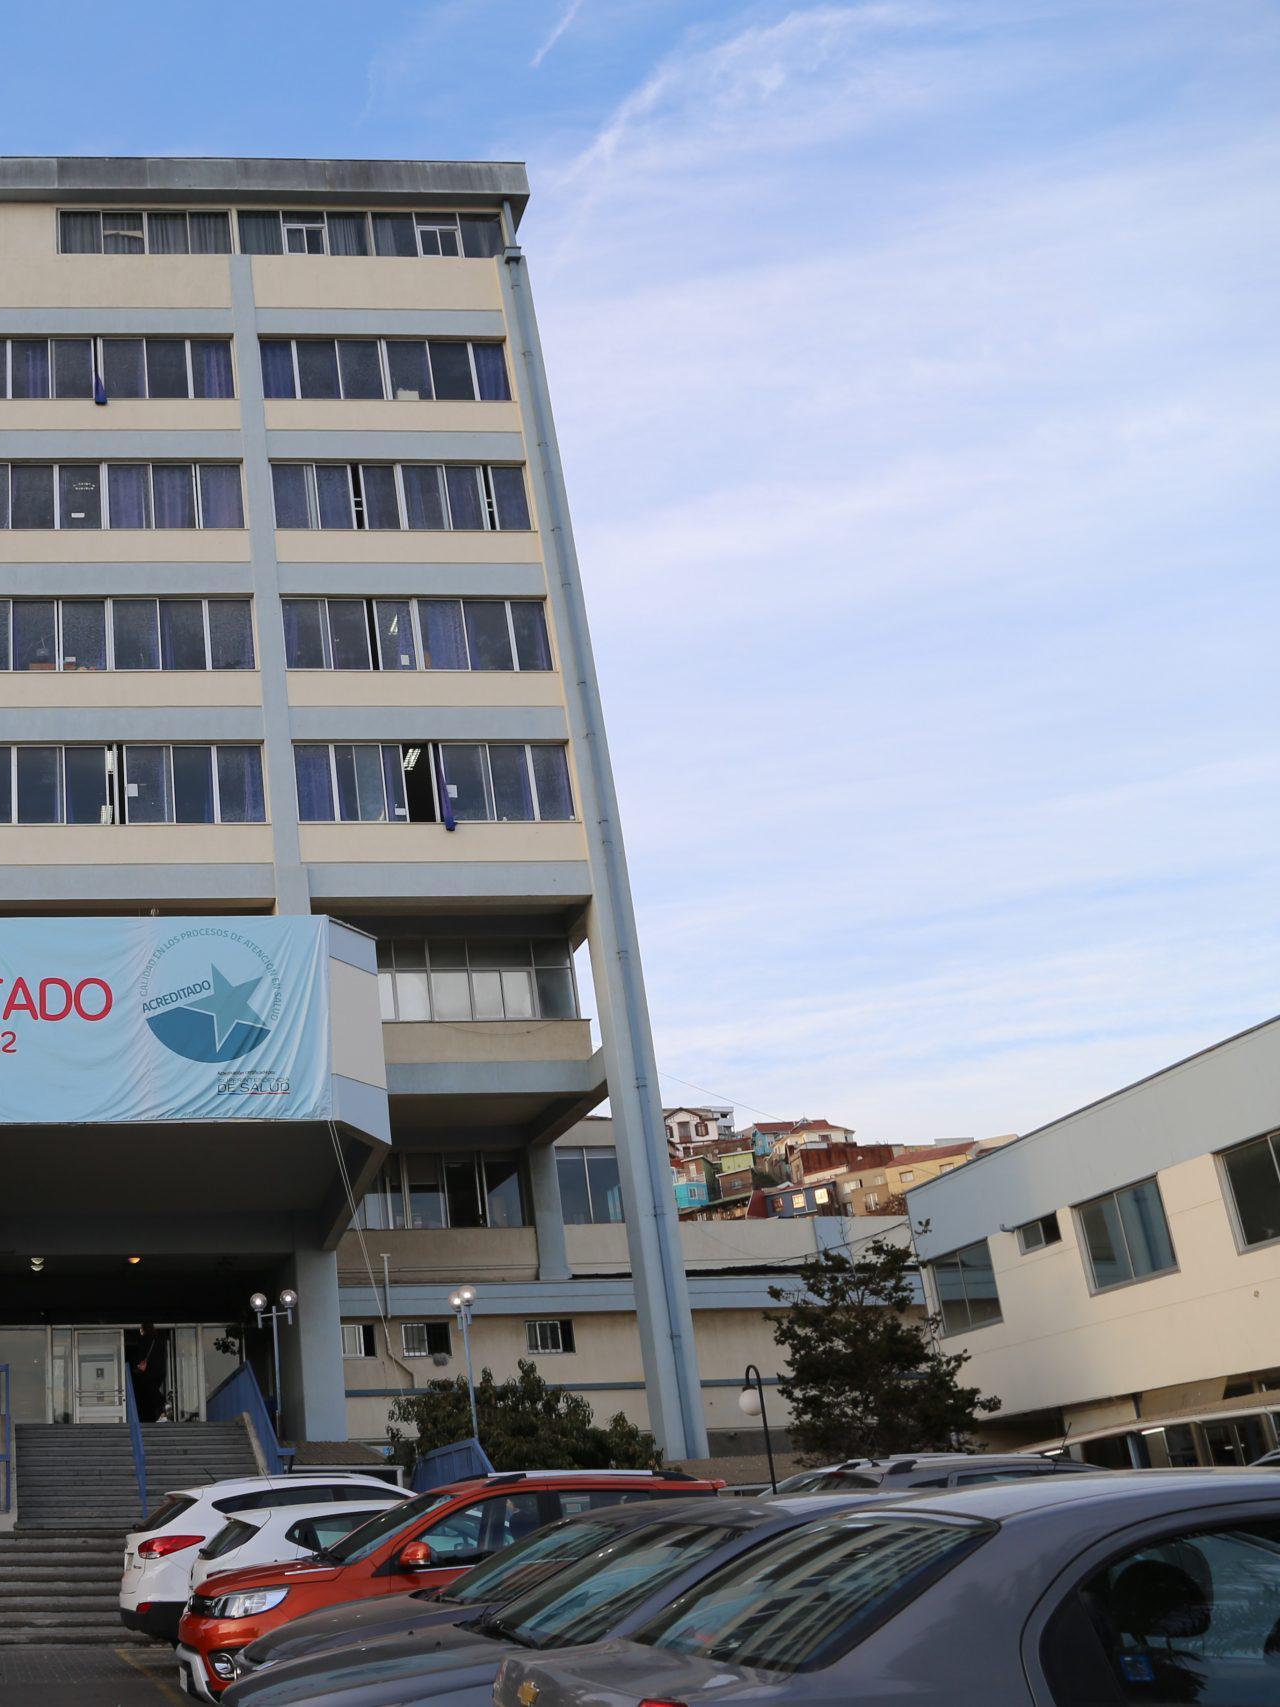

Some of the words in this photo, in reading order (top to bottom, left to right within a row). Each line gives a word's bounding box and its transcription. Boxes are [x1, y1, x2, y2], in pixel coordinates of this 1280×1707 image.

[139, 957, 155, 997] CALIDAD
[153, 947, 166, 961] EN
[164, 934, 181, 950] LOS
[180, 928, 229, 940] PROCESOS
[230, 931, 243, 943] DE
[142, 979, 211, 1013] ACREDITADO
[218, 1083, 236, 1093] DE
[240, 1082, 290, 1092] SALUD
